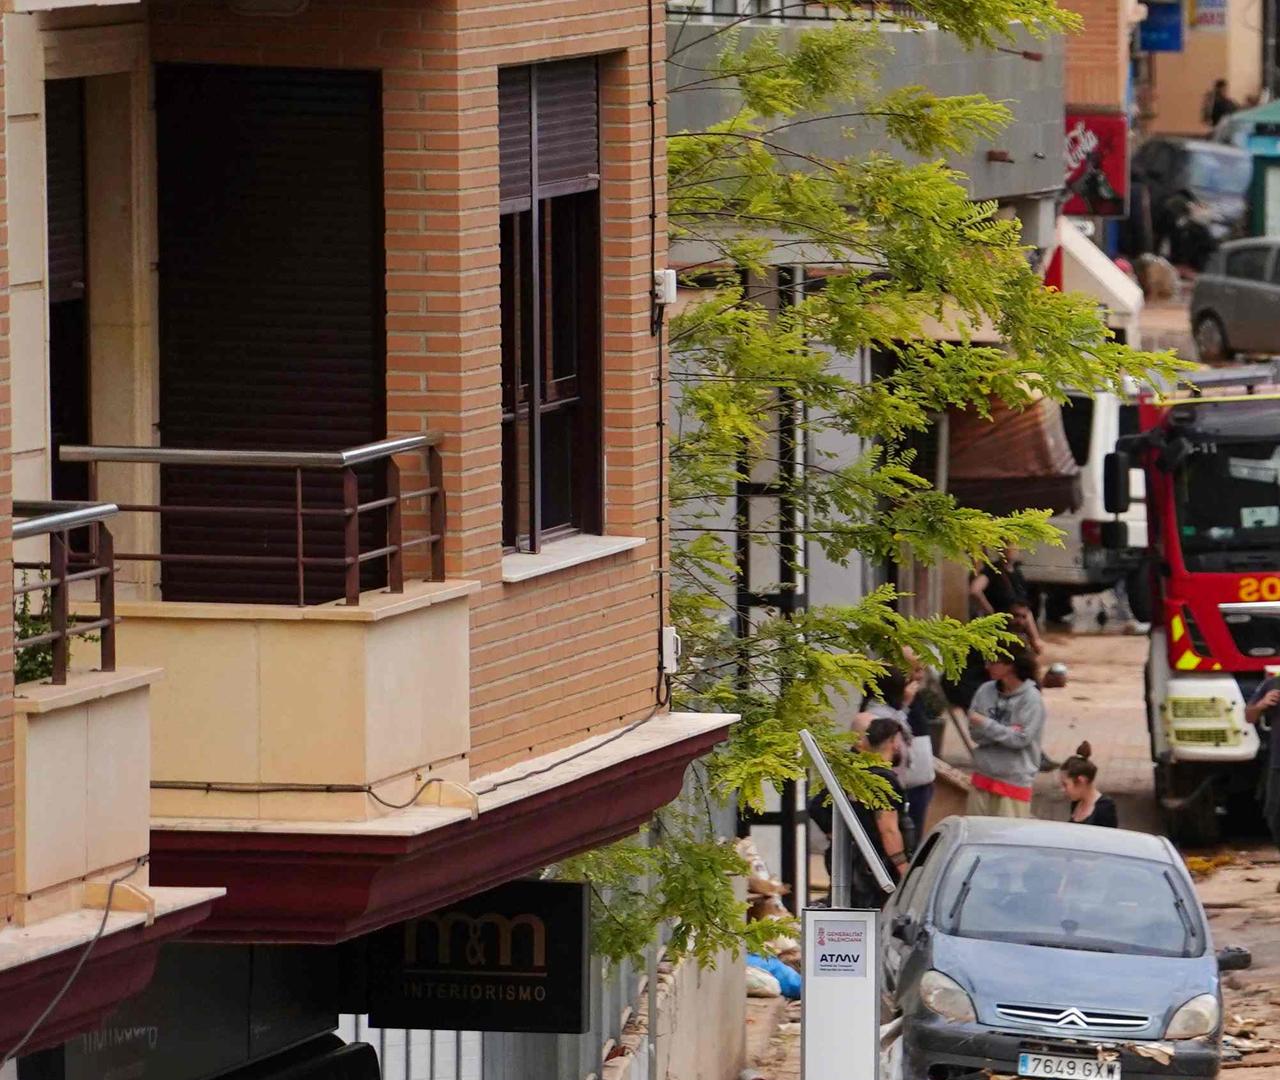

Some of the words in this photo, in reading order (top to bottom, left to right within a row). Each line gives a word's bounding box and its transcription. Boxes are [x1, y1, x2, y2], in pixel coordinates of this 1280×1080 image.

[820, 953, 860, 963] ATMV
[403, 983, 546, 1001] INTERIORISMO
[1031, 1058, 1077, 1076] 7649
[1082, 1061, 1117, 1080] GXW
